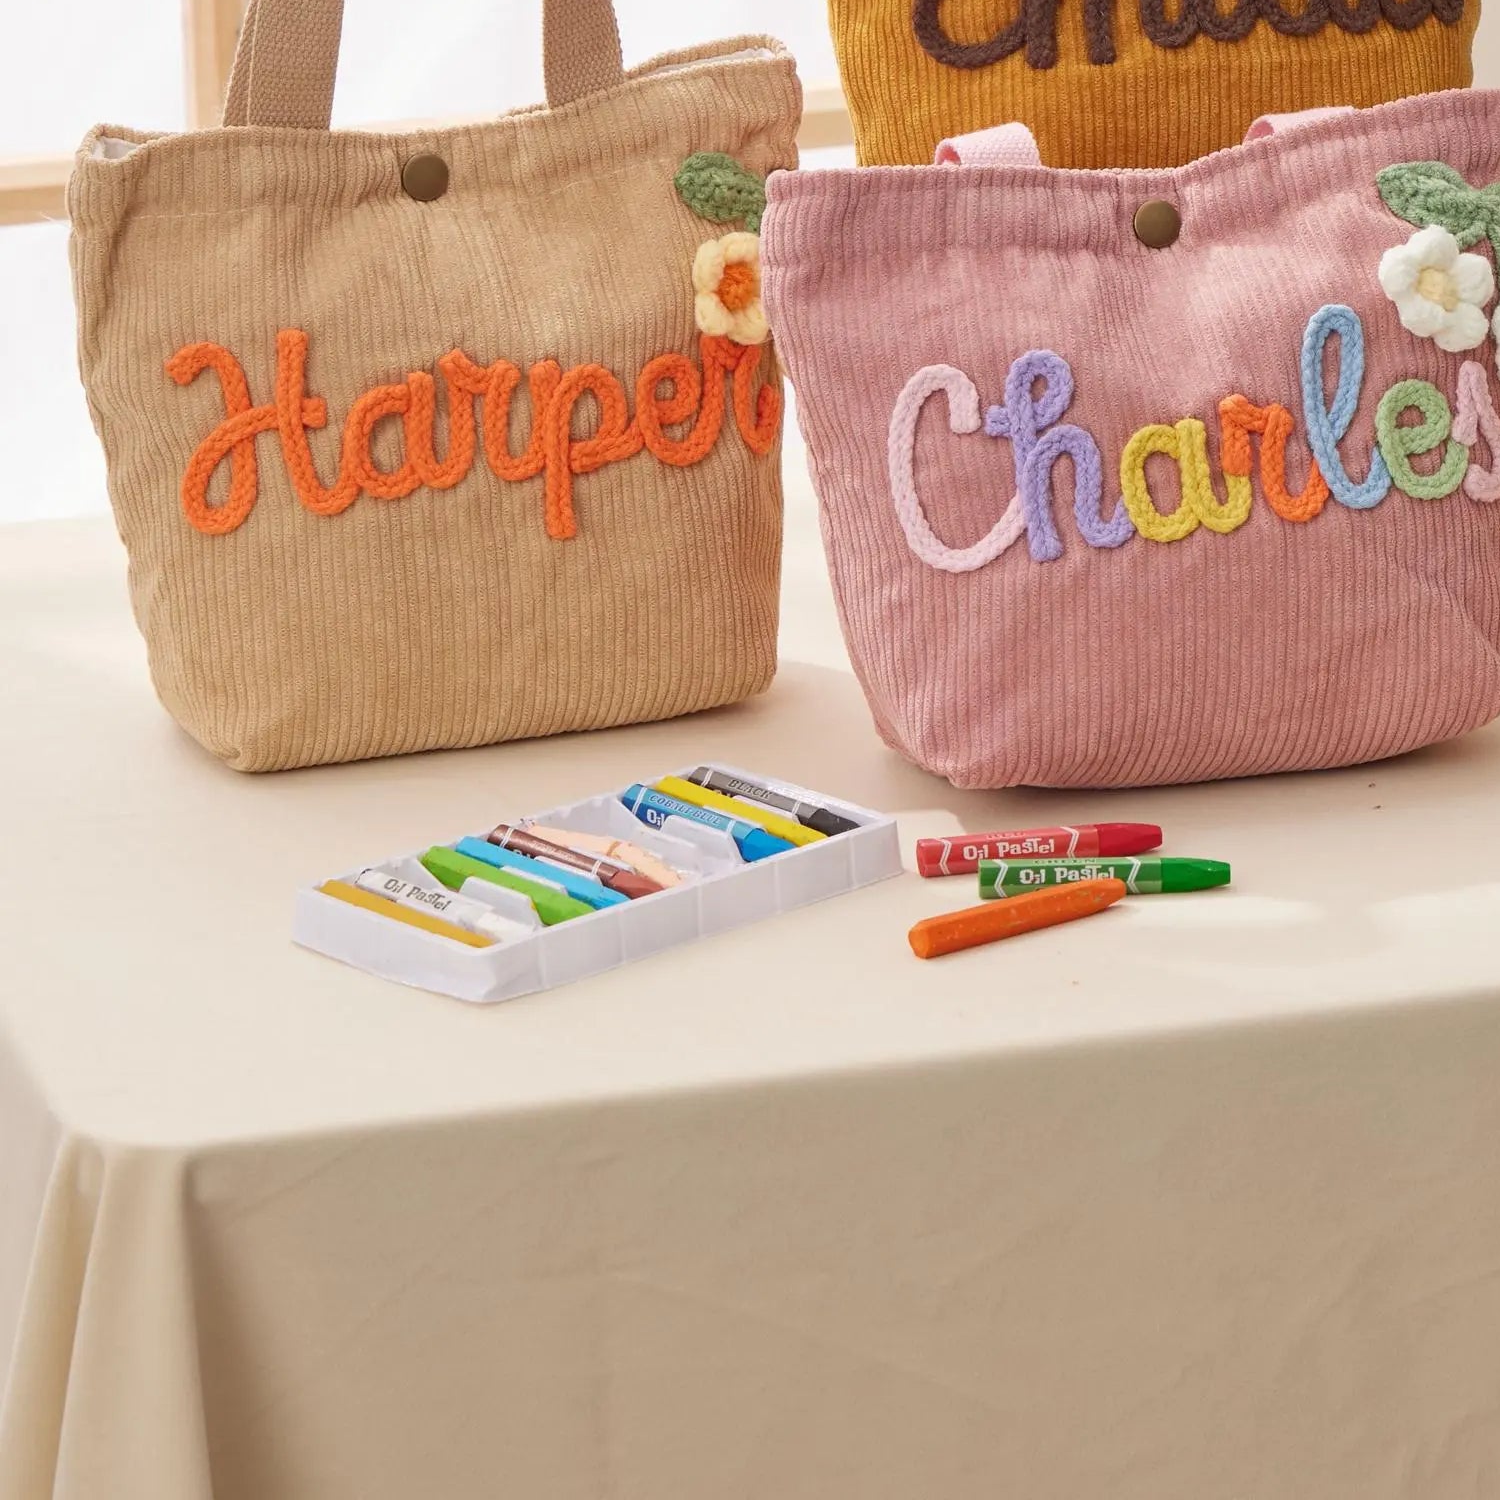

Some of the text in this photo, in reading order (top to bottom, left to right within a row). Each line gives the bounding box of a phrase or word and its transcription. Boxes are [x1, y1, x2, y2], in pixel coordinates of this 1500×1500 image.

[164, 329, 779, 540] Harper
[728, 779, 773, 800] BLACK
[963, 845, 989, 860] Oil
[1019, 869, 1045, 884] Oil
[384, 879, 407, 893] Oil
